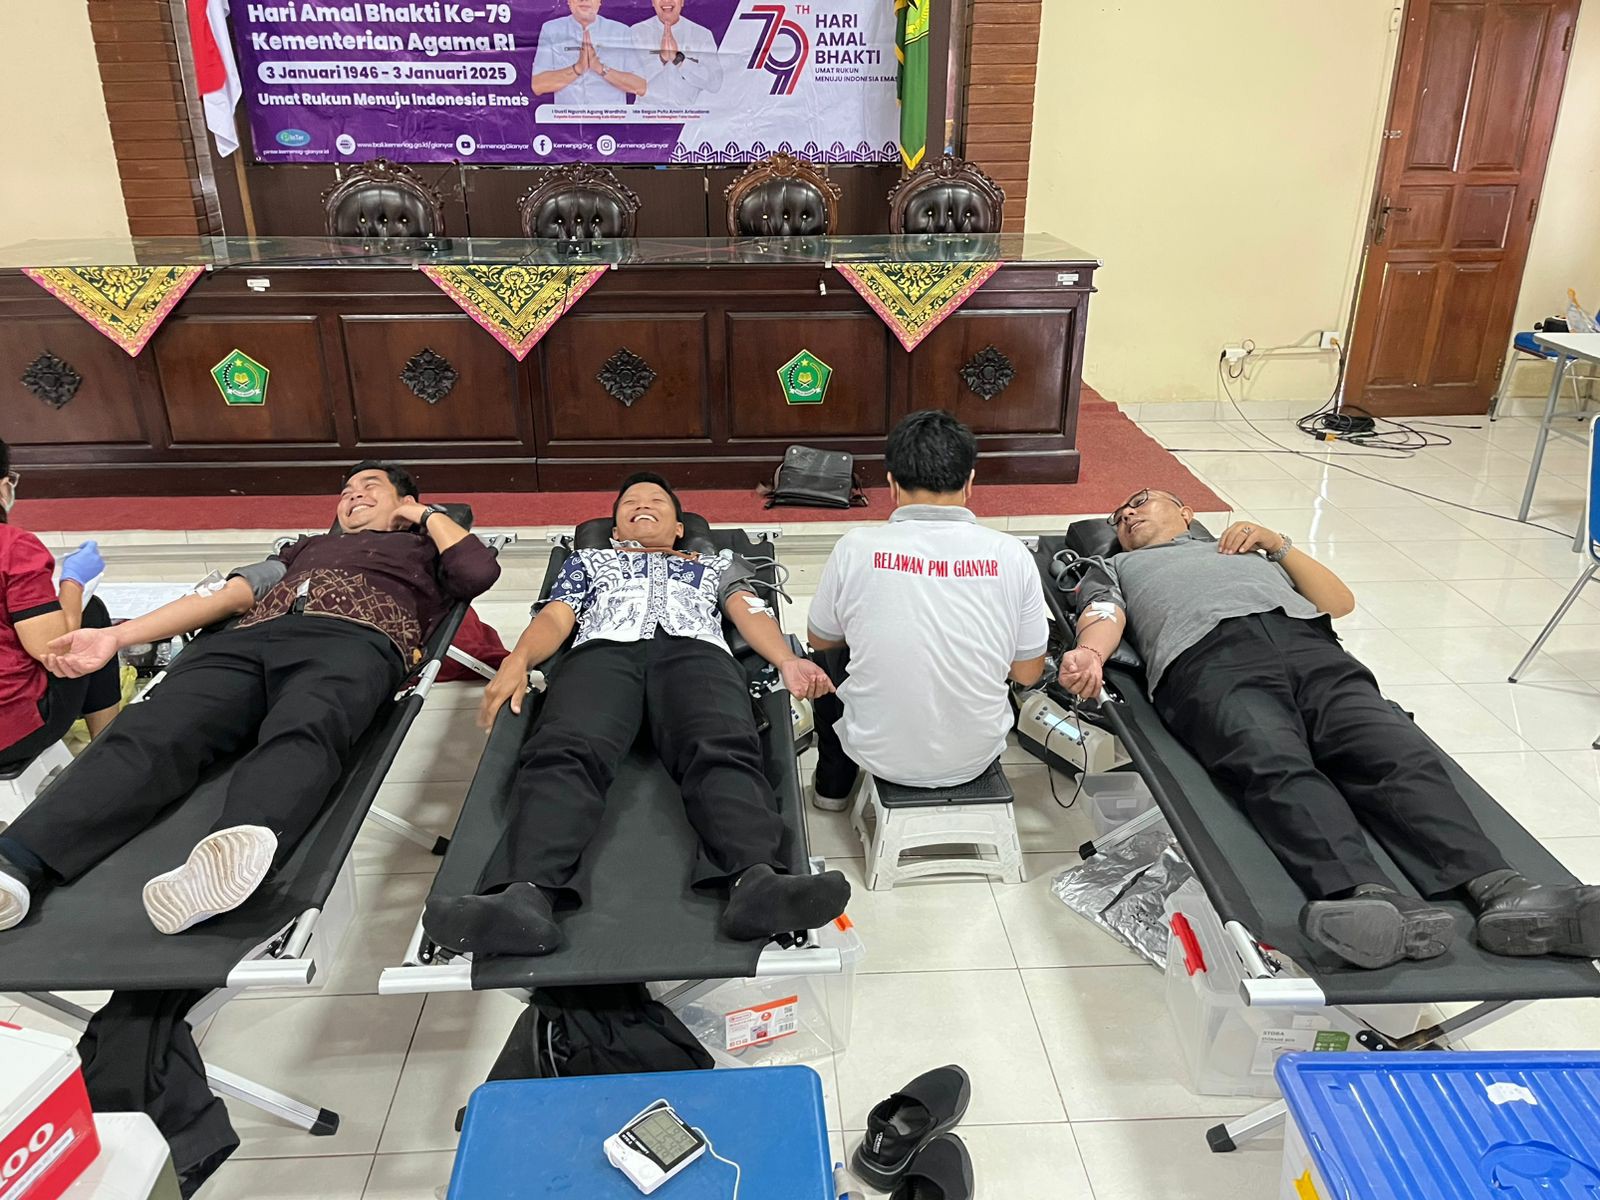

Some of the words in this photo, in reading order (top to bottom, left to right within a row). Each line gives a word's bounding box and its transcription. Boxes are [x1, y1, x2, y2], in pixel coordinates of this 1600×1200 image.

[247, 1, 297, 23] Hari
[300, 2, 363, 23] Amal
[364, 1, 441, 23] Bhakti
[443, 3, 511, 24] Ke-79
[795, 4, 810, 15] TH
[815, 13, 858, 29] HARI
[251, 29, 404, 51] Kementerian
[407, 32, 491, 57] Agama
[493, 33, 516, 51] RI
[815, 32, 867, 47] AMAL
[815, 49, 881, 65] BHAKTI
[266, 66, 275, 79] 3
[278, 65, 341, 79] Januari
[342, 66, 379, 79] 1946
[393, 66, 402, 79] 3
[405, 65, 467, 80] Januari
[469, 67, 507, 80] 2025
[257, 92, 301, 106] Umat
[301, 92, 351, 106] Rukun
[353, 91, 411, 109] Menuju
[411, 91, 487, 107] Indonesia
[487, 91, 530, 107] Emas
[873, 552, 925, 574] RELAWAN
[927, 560, 949, 577] PMI
[953, 559, 999, 577] GIANYAR
